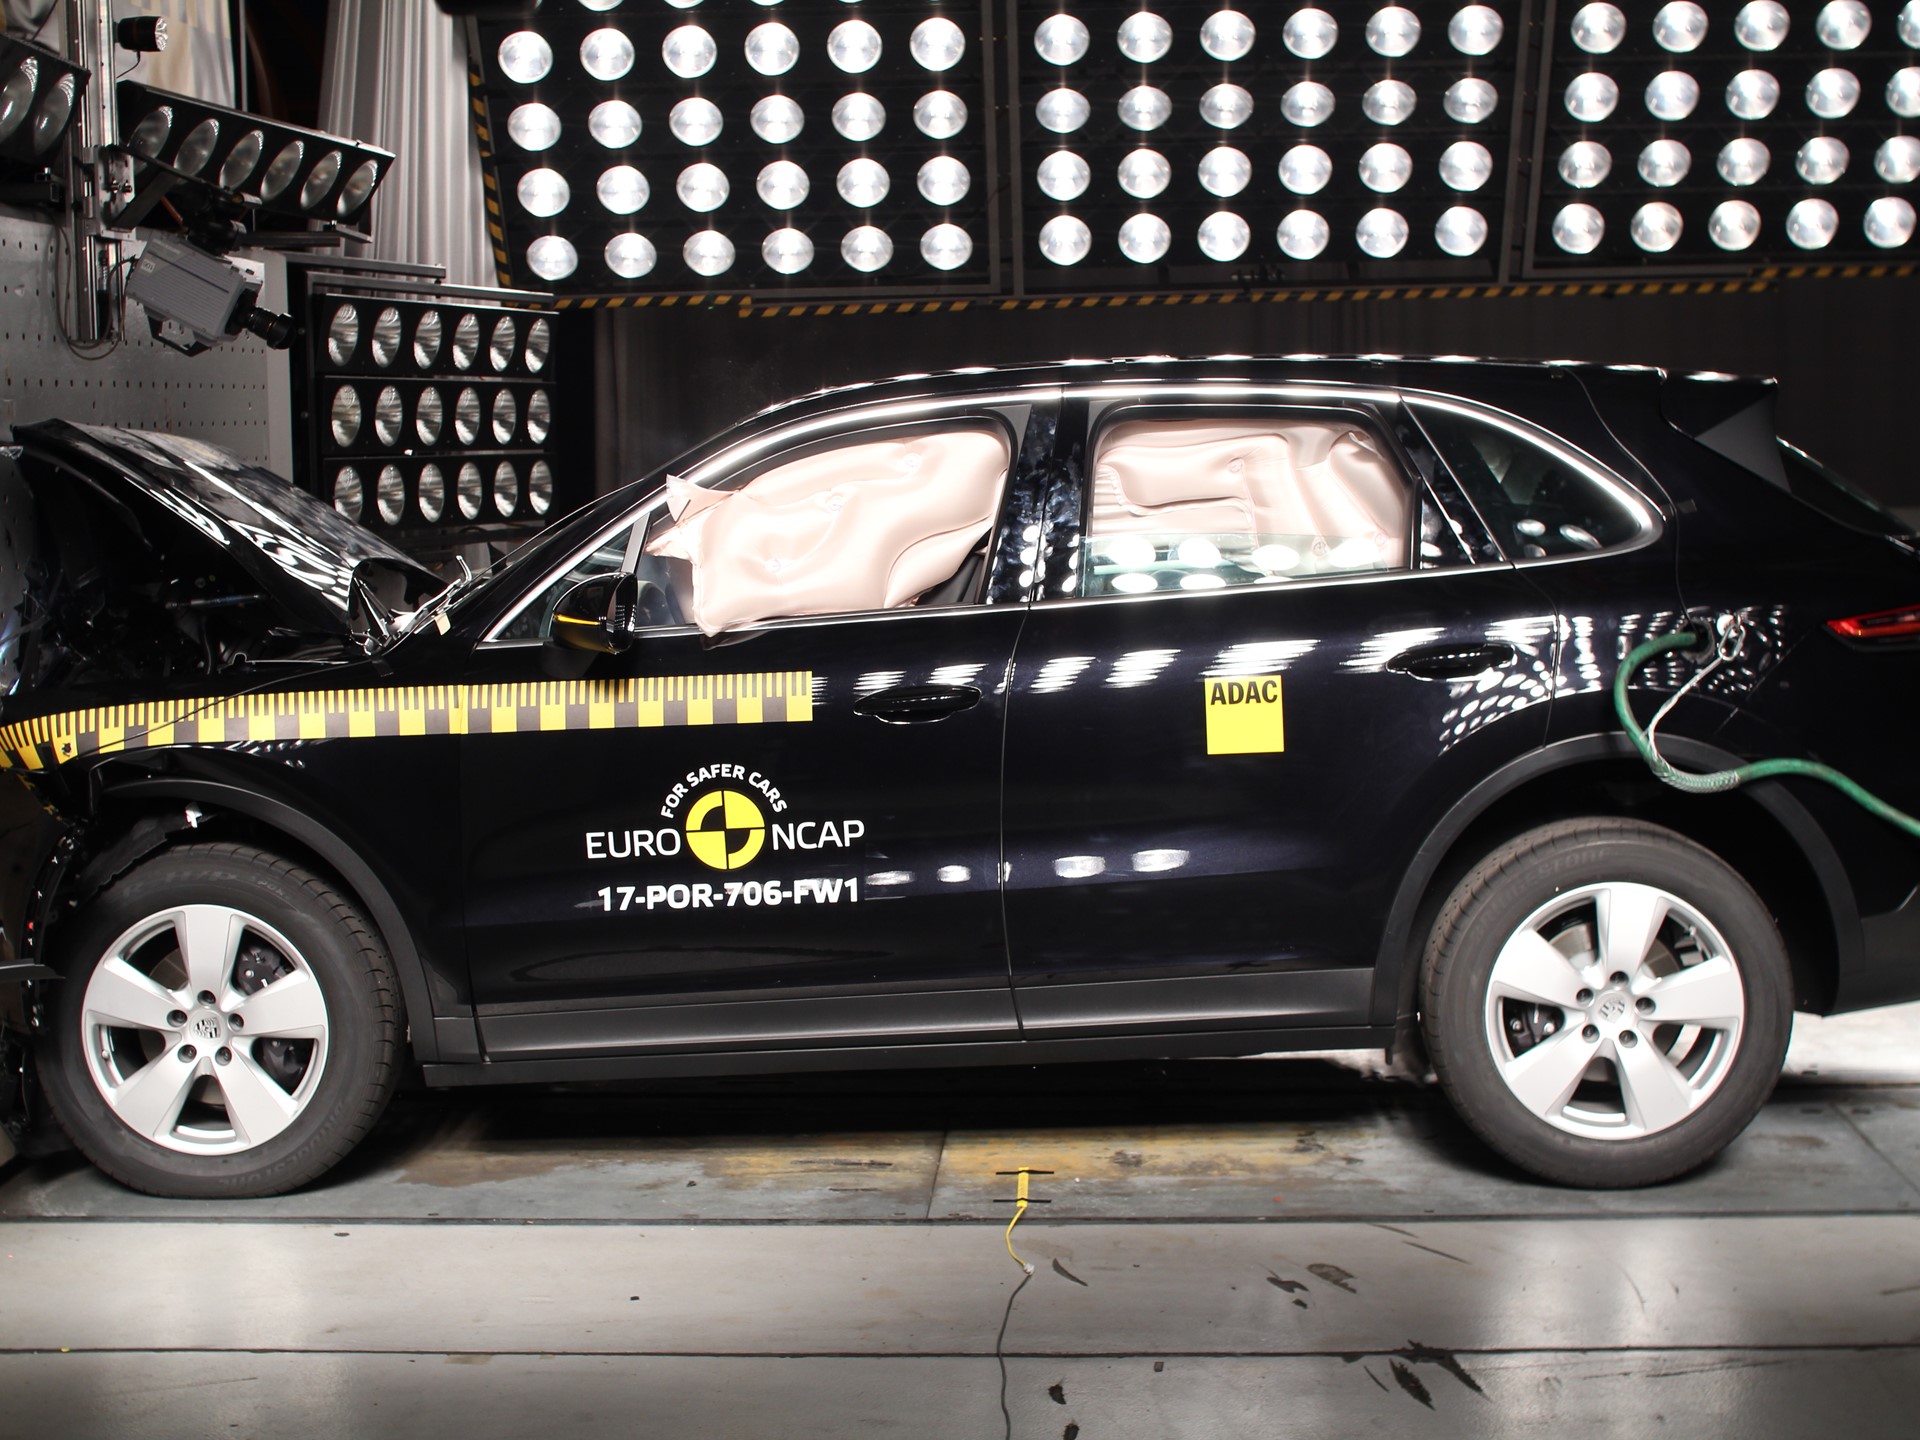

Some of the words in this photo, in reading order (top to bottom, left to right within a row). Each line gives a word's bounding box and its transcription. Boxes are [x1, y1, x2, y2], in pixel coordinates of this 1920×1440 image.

[1210, 680, 1278, 705] ADAC
[660, 782, 689, 819] FOR
[686, 763, 746, 788] SAFER
[748, 771, 788, 813] CARS
[585, 827, 681, 859] EURO
[771, 819, 865, 851] NCAP
[597, 877, 858, 912] 17-POR-706-FW1
